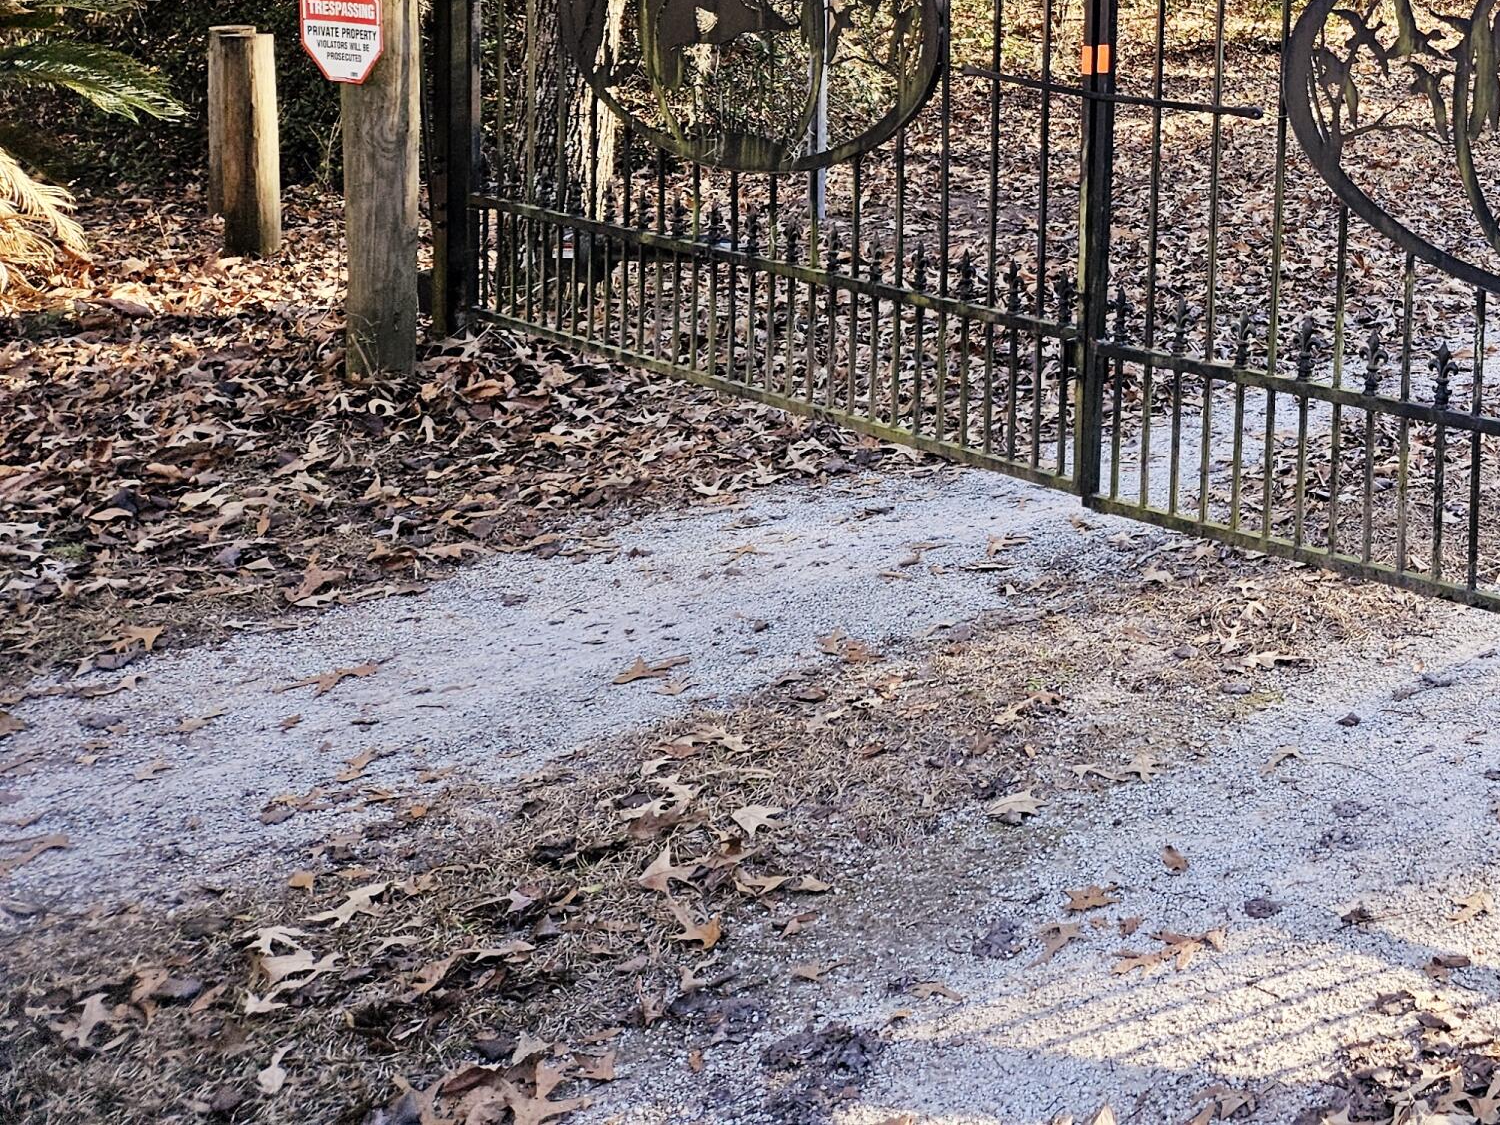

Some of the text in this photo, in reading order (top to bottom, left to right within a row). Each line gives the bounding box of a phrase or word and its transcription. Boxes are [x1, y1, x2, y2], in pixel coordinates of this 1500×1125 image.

[307, 0, 376, 20] TRESPASSING
[307, 25, 377, 41] PRIVATE PROPERTY
[316, 39, 370, 52] VIOLATORS WILL BE
[326, 51, 362, 63] PROSECUTED
